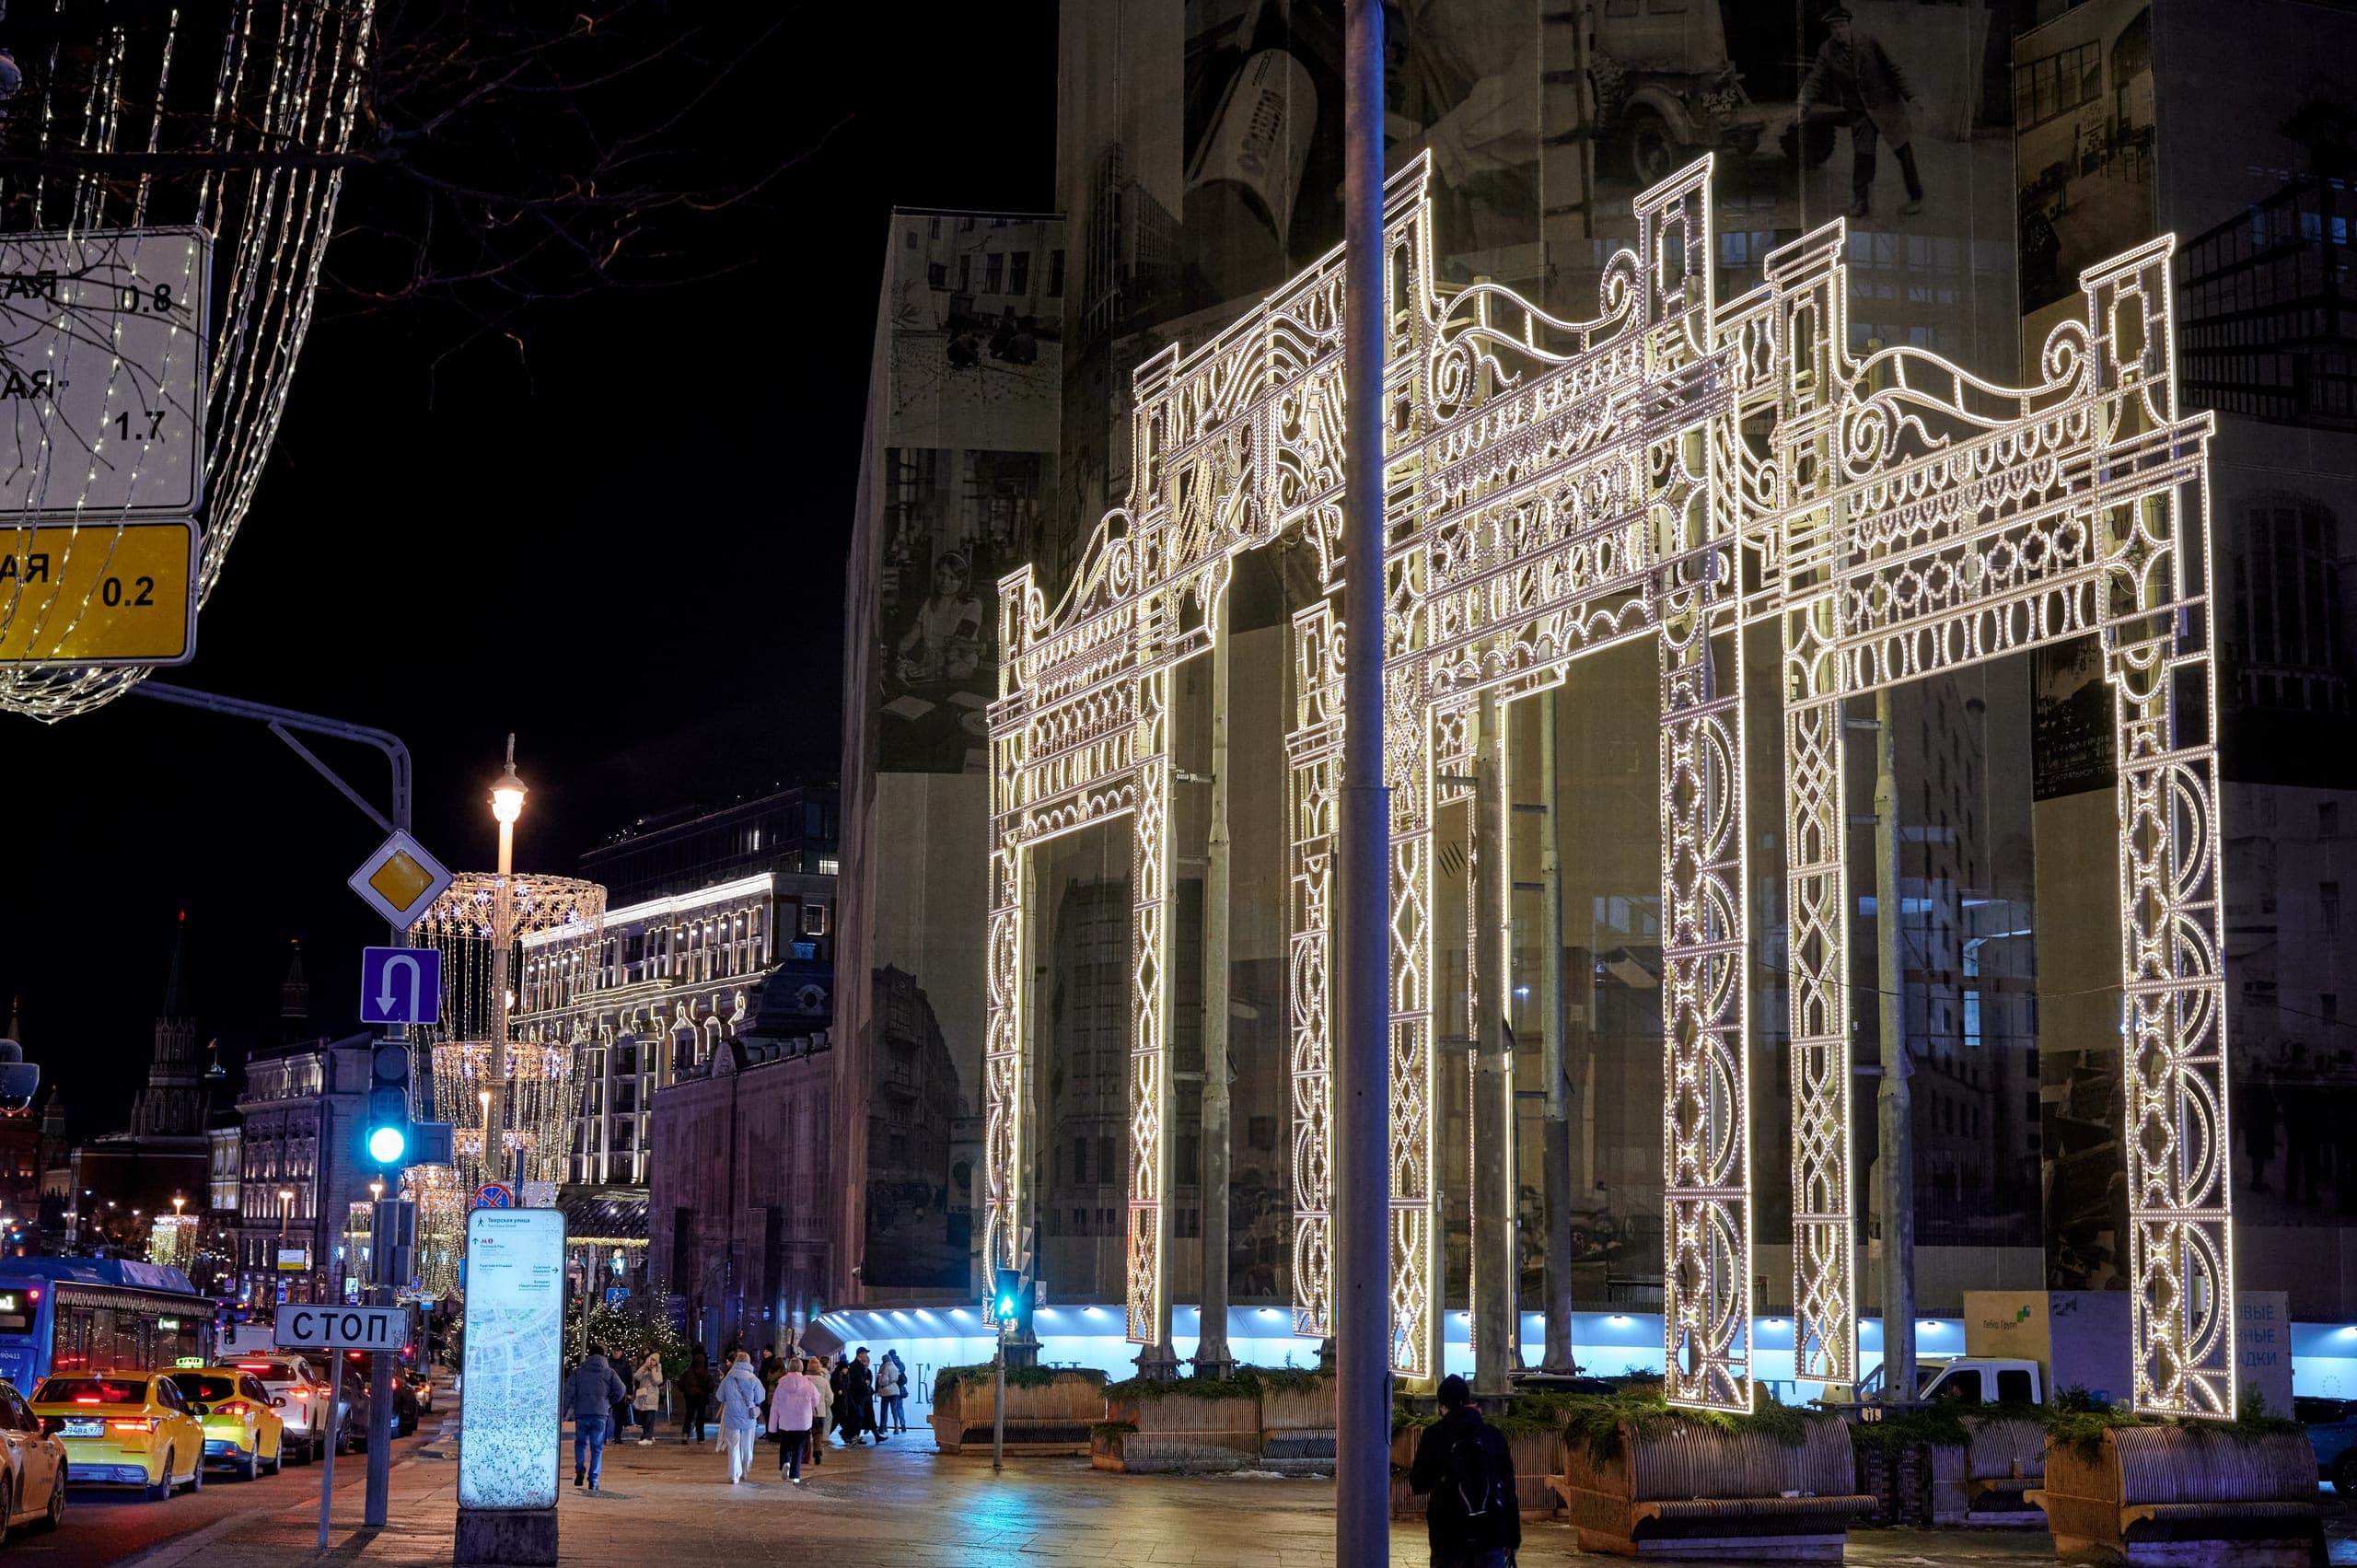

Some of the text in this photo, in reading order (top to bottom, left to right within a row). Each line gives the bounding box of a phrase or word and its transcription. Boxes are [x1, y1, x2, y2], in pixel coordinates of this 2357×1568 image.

[0, 270, 57, 300] АЯ
[122, 284, 172, 313] 0.8
[115, 411, 166, 441] 1.7
[0, 553, 50, 584] АЯ
[102, 576, 155, 607] 0.2
[293, 1312, 388, 1342] СТОП
